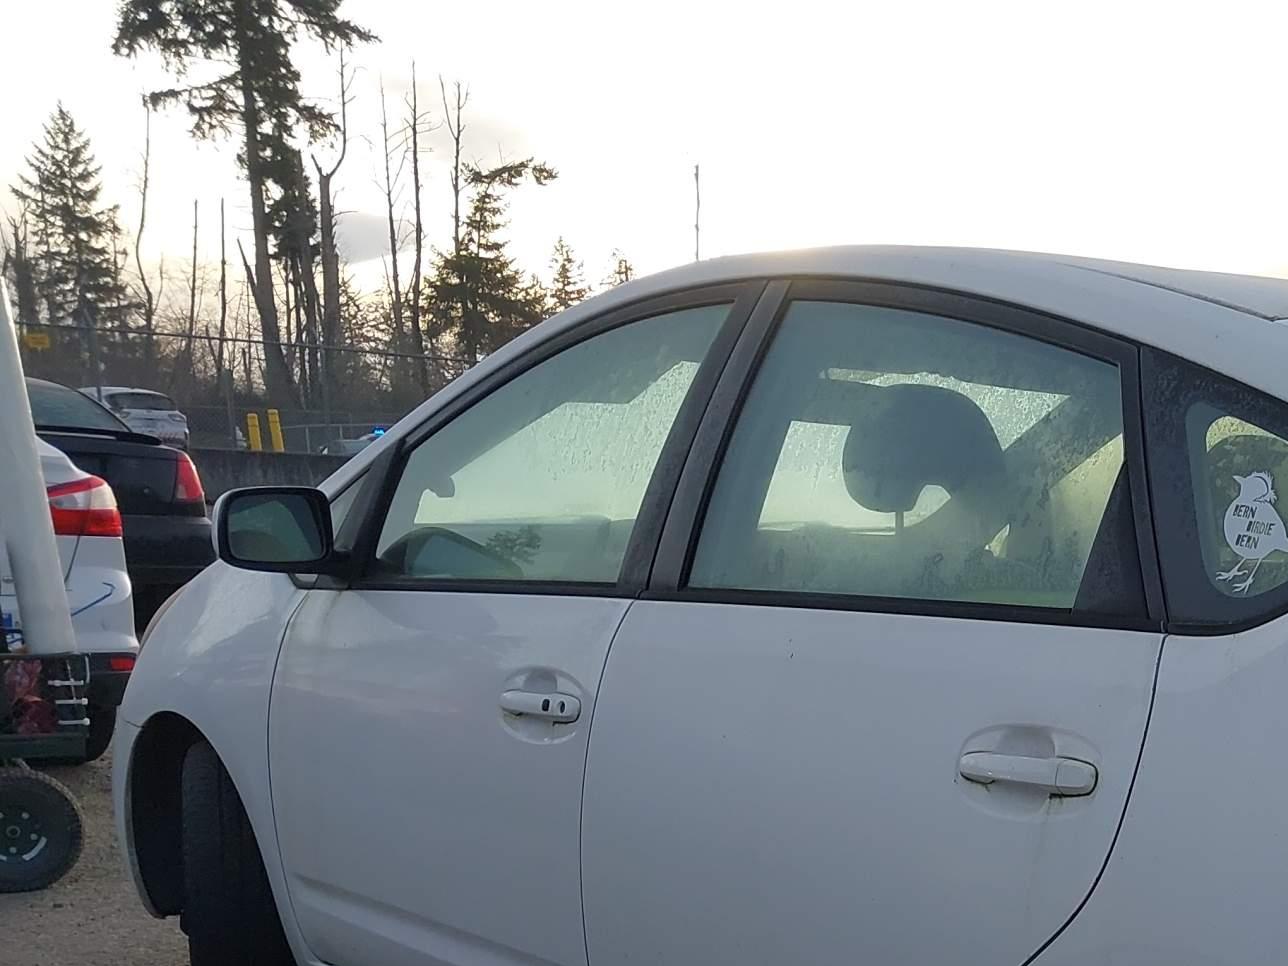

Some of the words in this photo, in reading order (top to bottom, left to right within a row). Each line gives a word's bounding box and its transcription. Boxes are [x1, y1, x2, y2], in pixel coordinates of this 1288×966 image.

[1232, 504, 1258, 519] BERN
[1246, 521, 1276, 536] BIRDIE
[1235, 534, 1260, 550] BERN
